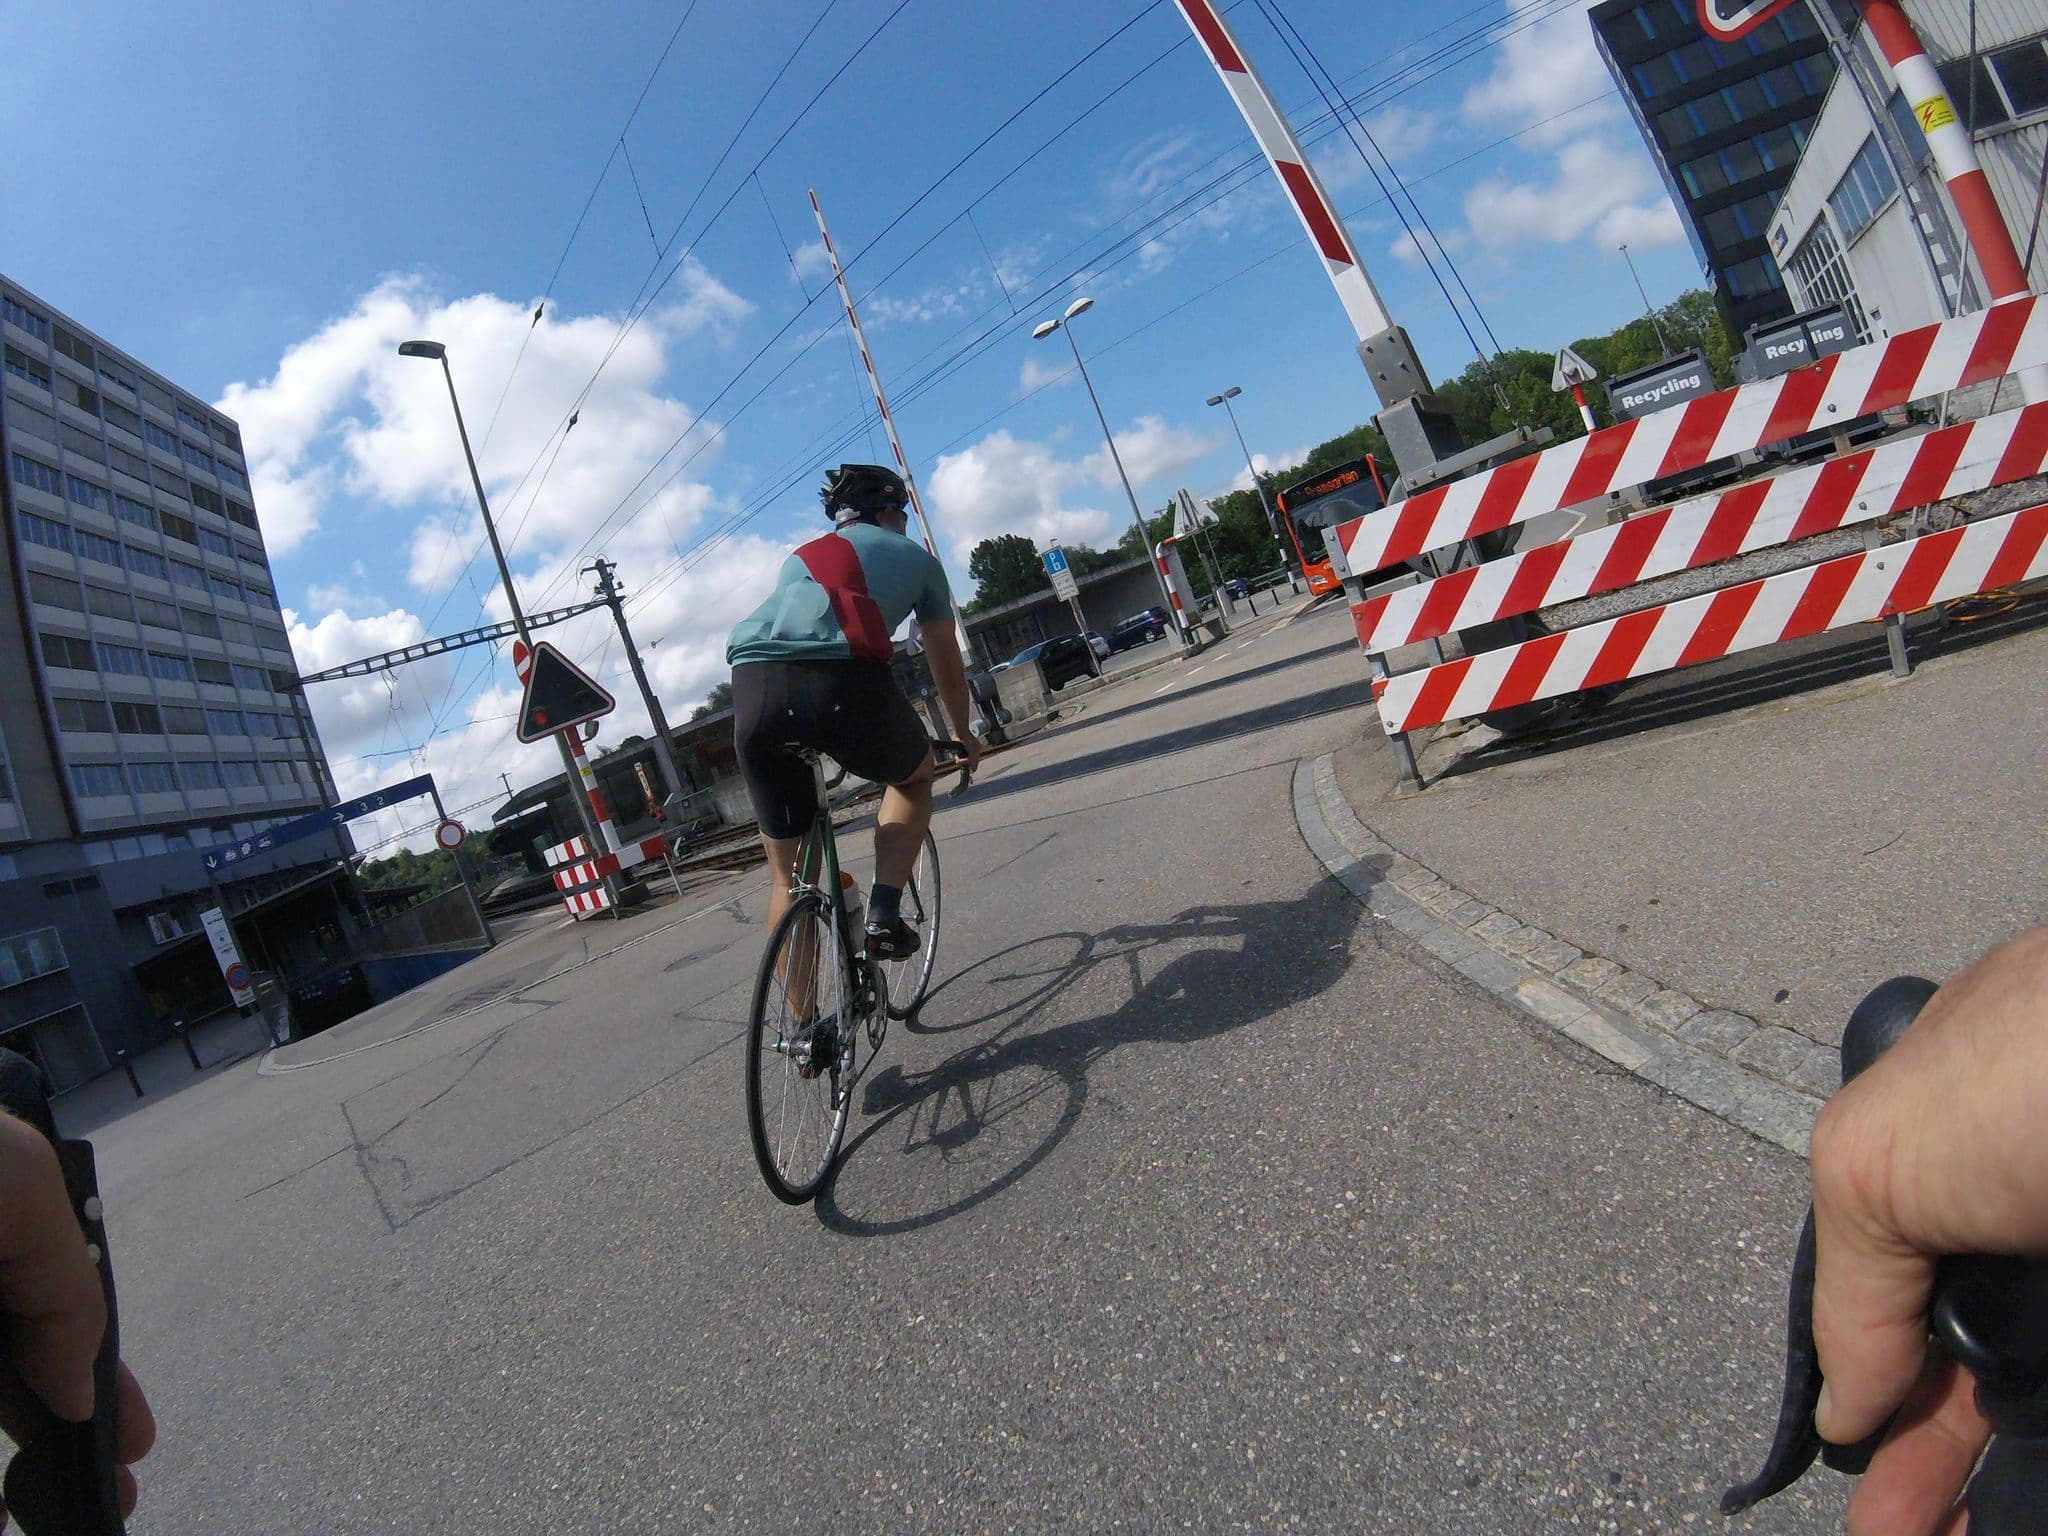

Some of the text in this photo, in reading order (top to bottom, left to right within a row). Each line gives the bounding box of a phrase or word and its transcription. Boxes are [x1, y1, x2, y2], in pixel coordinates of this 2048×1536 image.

[1765, 326, 1844, 360] Recyling
[1621, 374, 1701, 409] Recycling
[360, 796, 385, 811] 3 2
